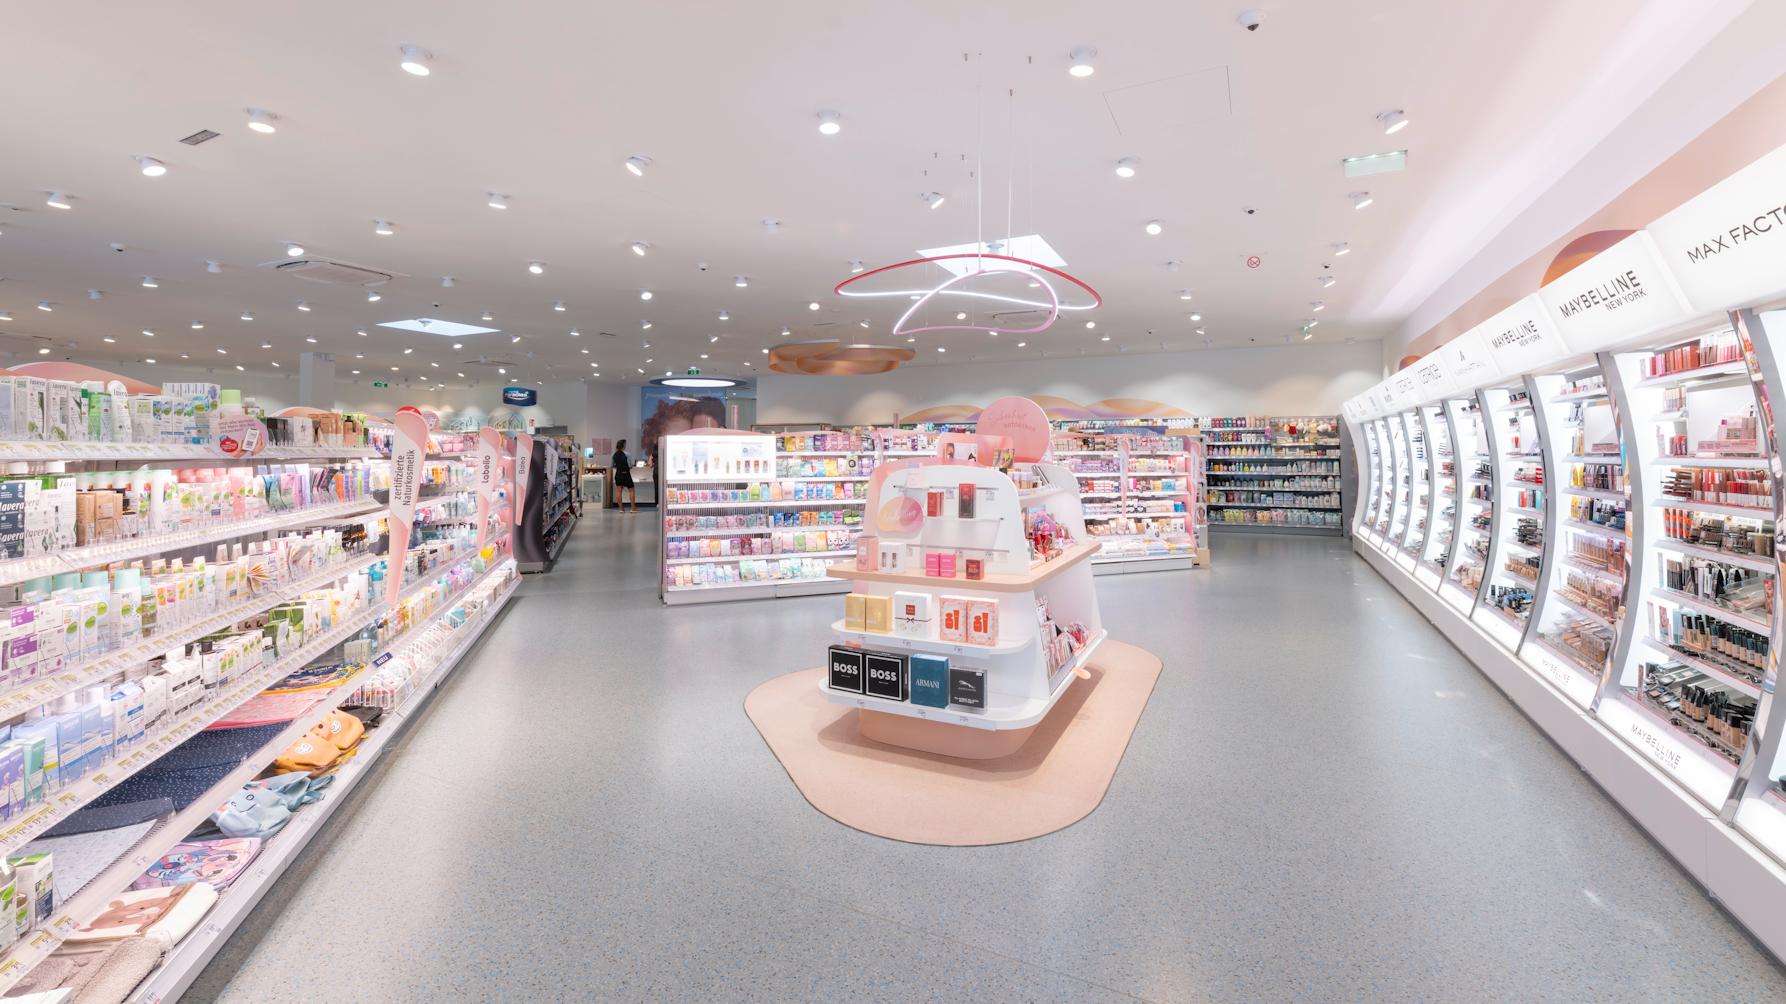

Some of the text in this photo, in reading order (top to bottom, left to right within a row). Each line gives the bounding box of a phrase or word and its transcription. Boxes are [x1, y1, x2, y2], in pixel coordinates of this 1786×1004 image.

[1687, 204, 1786, 264] MAX FACT
[1559, 270, 1641, 319] MAYBELLINE
[1605, 288, 1647, 311] NEW YORK
[1491, 320, 1538, 349] MAYBELLINE
[394, 455, 405, 500] zertifizierte
[402, 449, 416, 506] Naturkosmetik
[481, 455, 491, 483] Labello
[833, 661, 859, 675] BOSS
[870, 668, 897, 682] BOSS
[915, 678, 940, 689] ARMANI
[1631, 723, 1681, 766] MAYBELLINE
